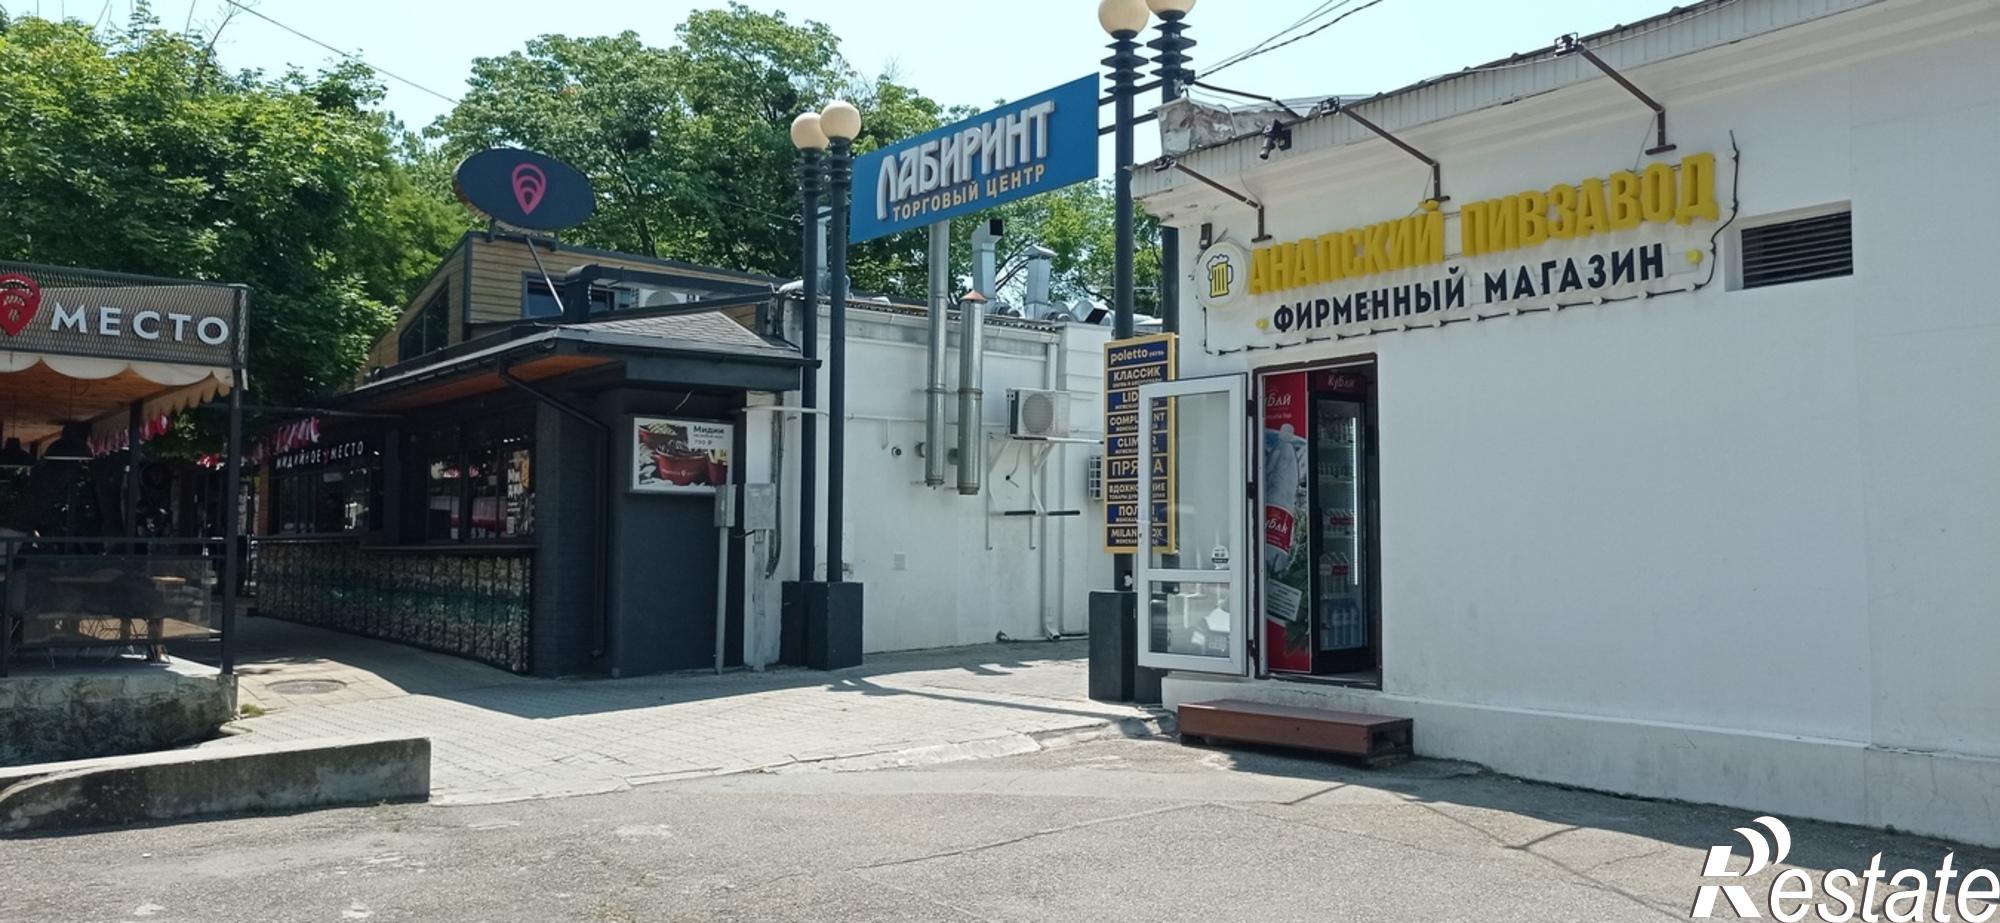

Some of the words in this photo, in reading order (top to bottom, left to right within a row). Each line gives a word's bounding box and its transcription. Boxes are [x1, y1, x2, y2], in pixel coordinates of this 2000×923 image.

[876, 100, 1055, 220] ЛАБИРИНТ
[892, 181, 979, 222] ТОРГОВЫЙ
[986, 163, 1045, 198] ЦЕНТР
[1249, 200, 1446, 294] АНАПСКИЙ
[1460, 152, 1719, 257] ПИВЗАВОД
[50, 302, 229, 345] МЕСТО
[1273, 267, 1466, 333] ФИРМЕННЫЙ
[1484, 243, 1664, 304] МАГАЗИН
[1113, 366, 1160, 382] КЛАССИК
